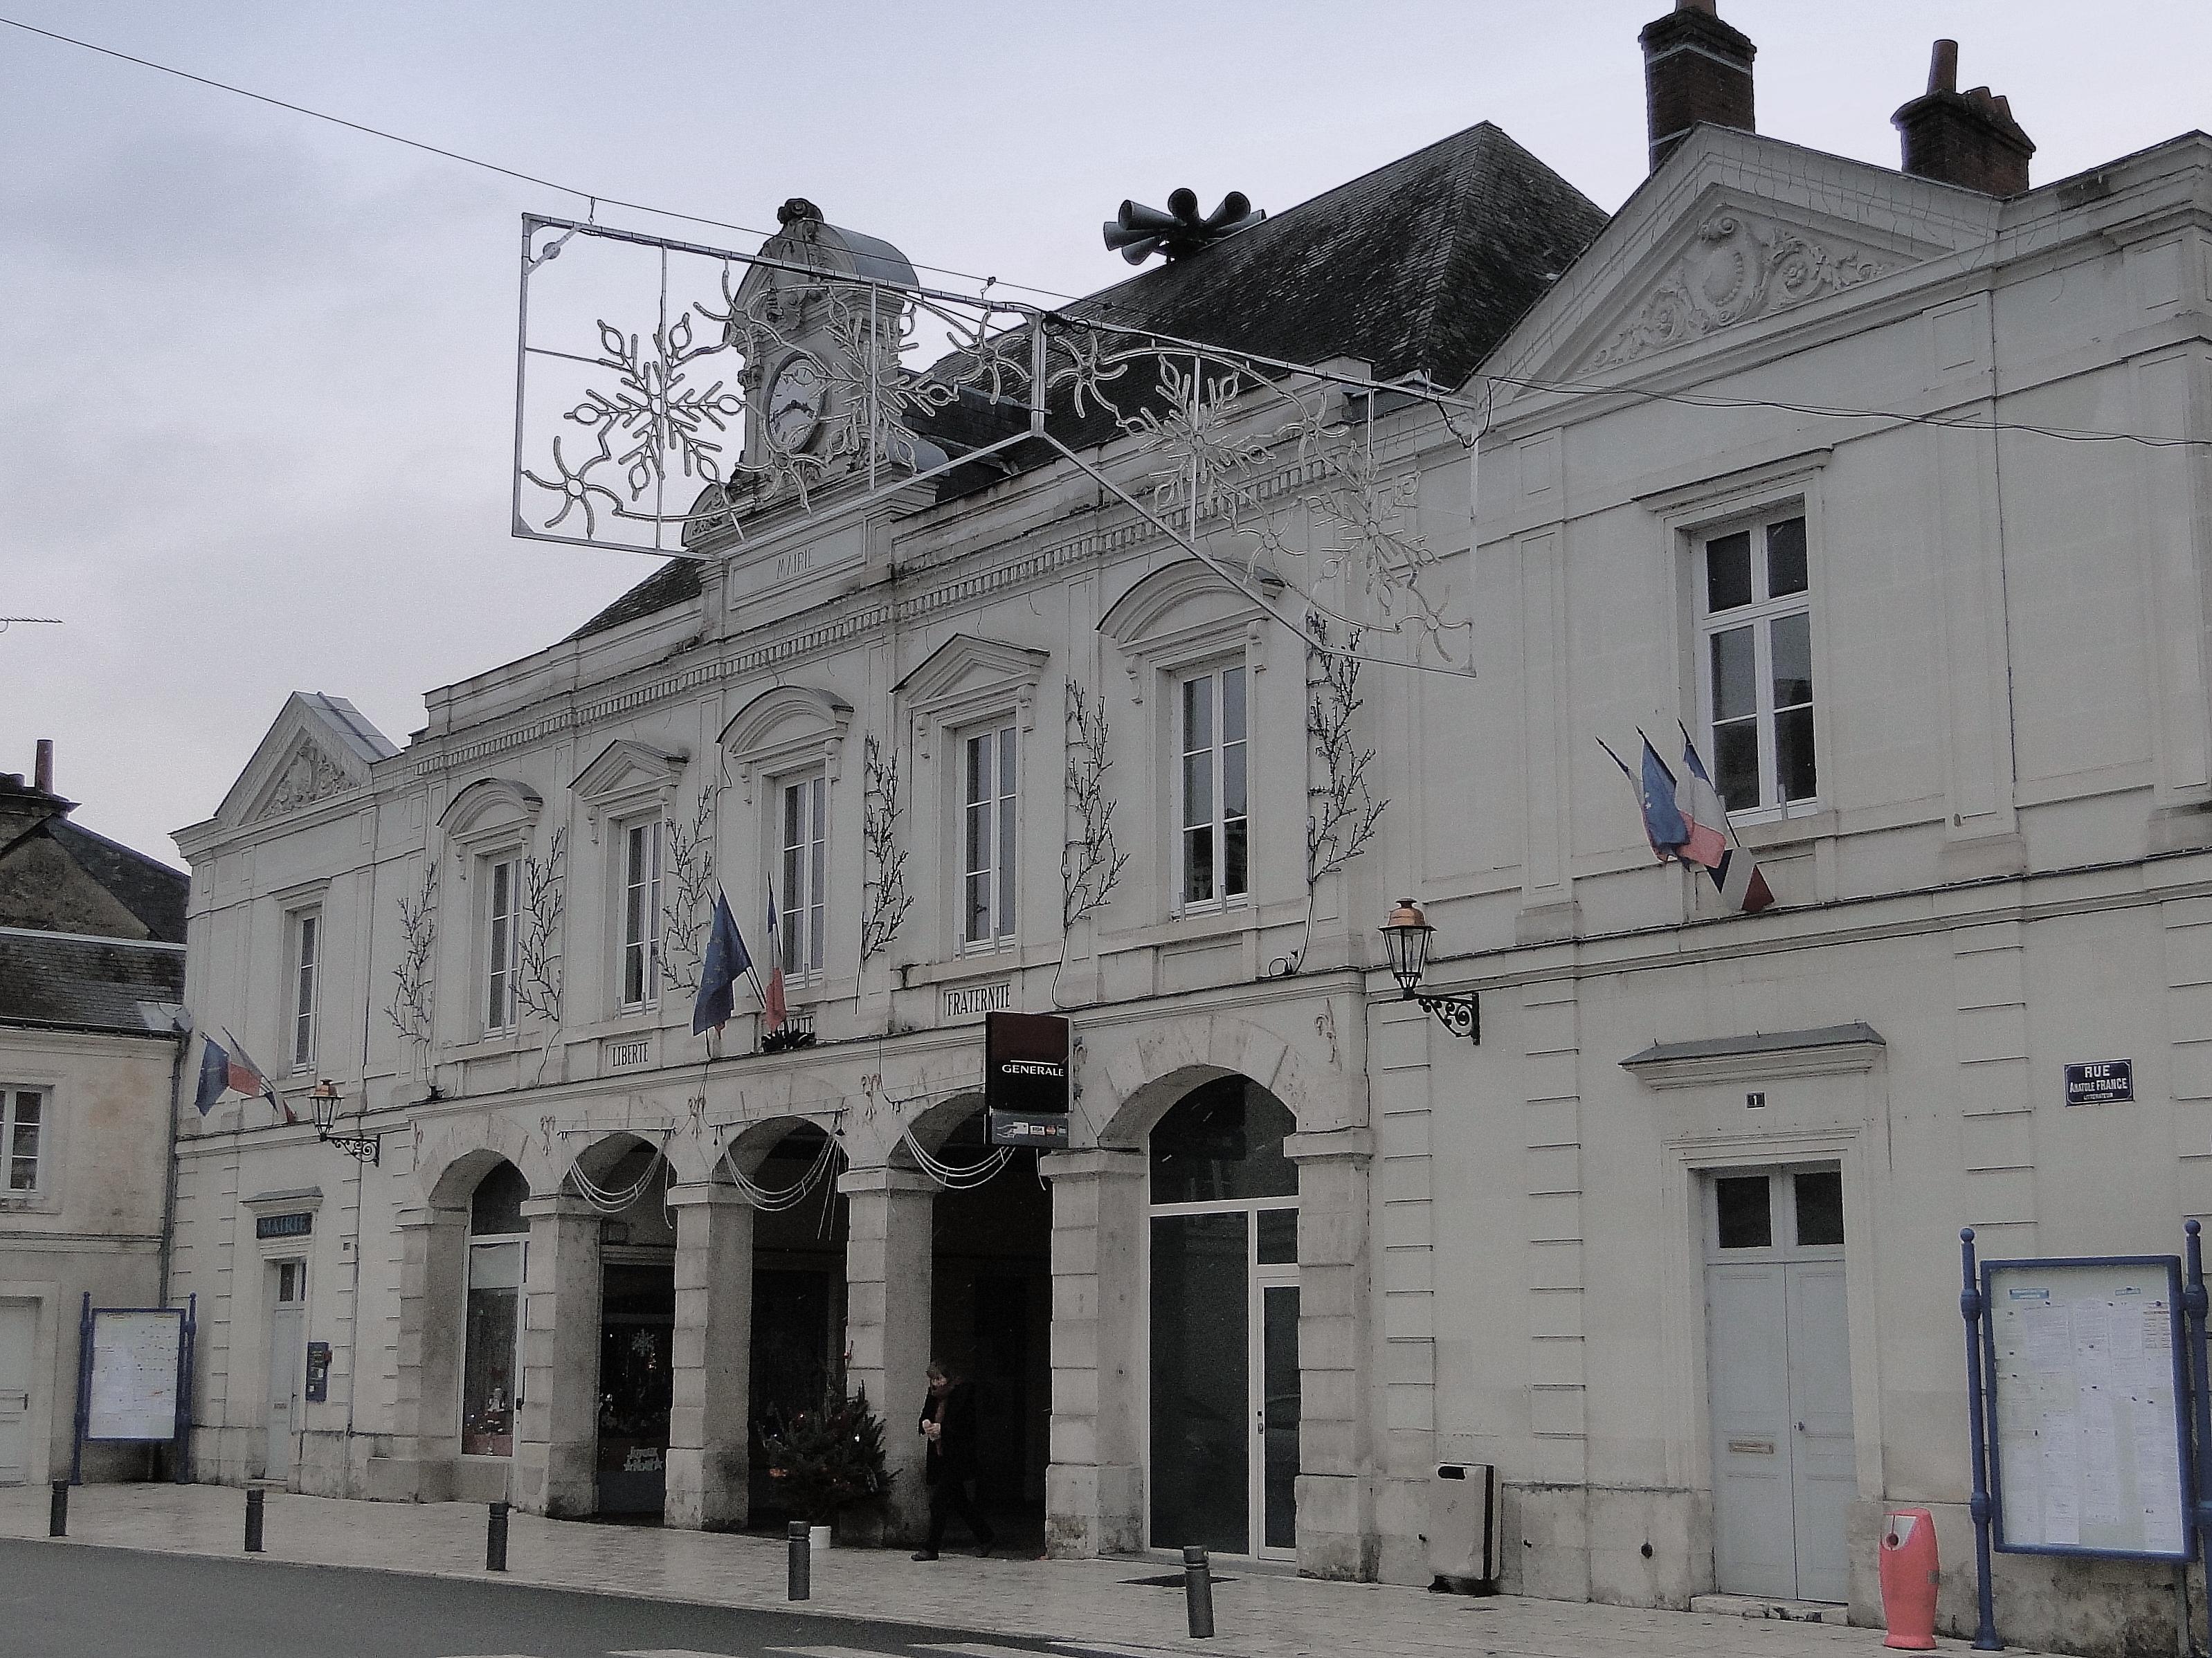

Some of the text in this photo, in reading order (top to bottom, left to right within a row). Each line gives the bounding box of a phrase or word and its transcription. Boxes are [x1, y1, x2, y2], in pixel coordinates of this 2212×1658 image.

[613, 1042, 649, 1067] LIBERTE
[1001, 1064, 1064, 1077] GENERALE
[2085, 1065, 2110, 1078] RUE
[2096, 1078, 2128, 1091] FRANCE
[1753, 1095, 1757, 1105] 1
